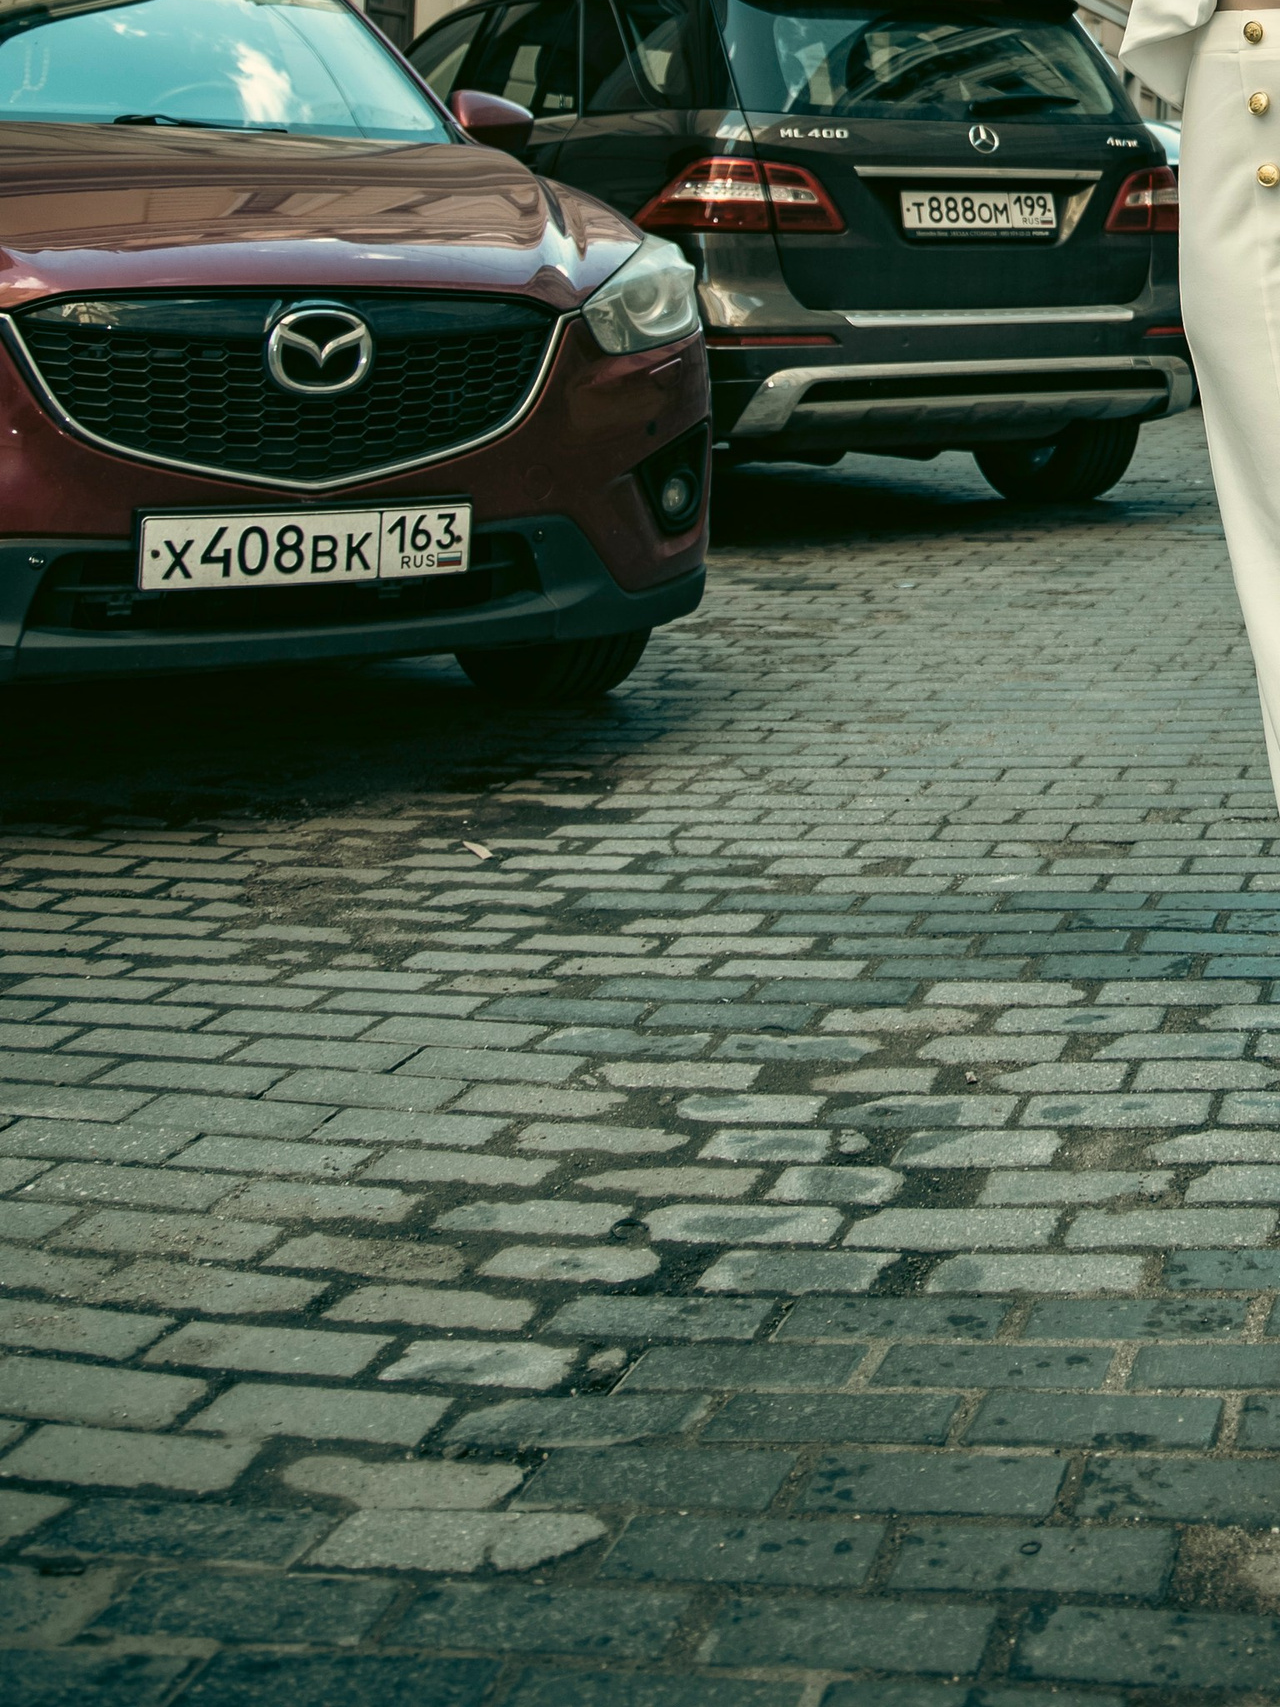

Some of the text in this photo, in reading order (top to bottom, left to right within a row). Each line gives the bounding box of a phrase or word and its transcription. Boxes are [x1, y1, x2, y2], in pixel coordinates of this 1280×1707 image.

[779, 127, 849, 139] ML 400
[911, 195, 1047, 225] Т888ОМ 199
[1022, 217, 1040, 225] RUS
[161, 512, 457, 580] Х408ВК 163
[400, 554, 436, 570] RUS
